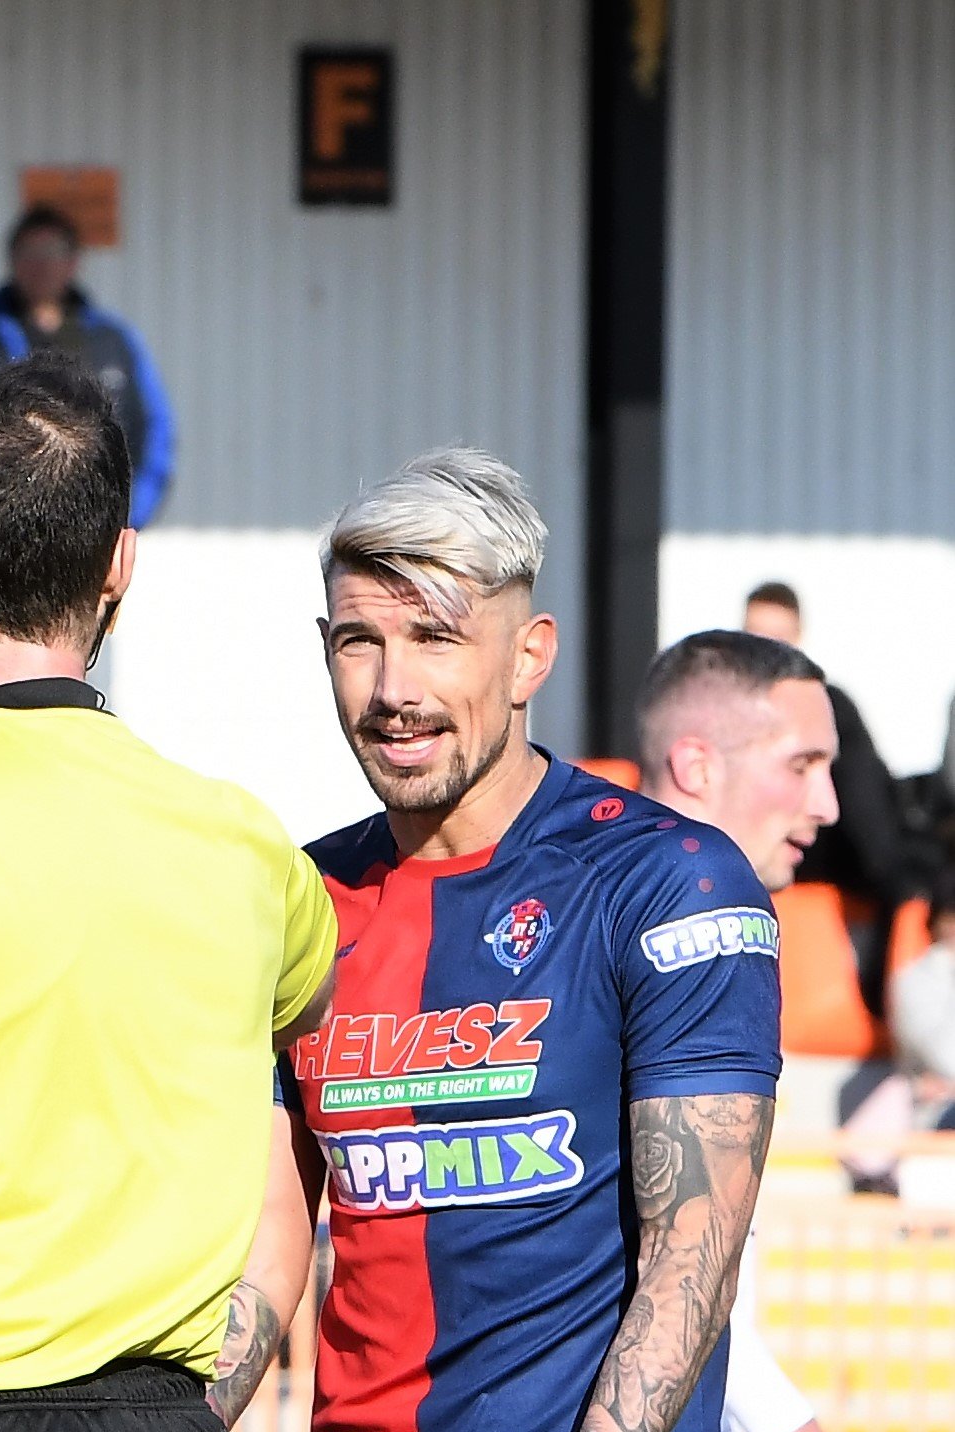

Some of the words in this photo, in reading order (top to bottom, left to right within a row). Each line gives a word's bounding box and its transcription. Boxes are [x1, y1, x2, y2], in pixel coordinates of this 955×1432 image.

[311, 62, 379, 161] F
[295, 998, 552, 1080] REVESZ
[325, 1085, 382, 1105] ALWAYS
[383, 1084, 403, 1100] ON
[407, 1082, 436, 1099] THE
[438, 1076, 485, 1095] RIGHT
[487, 1073, 531, 1092] WAY
[321, 1121, 570, 1197] iPPMIX
